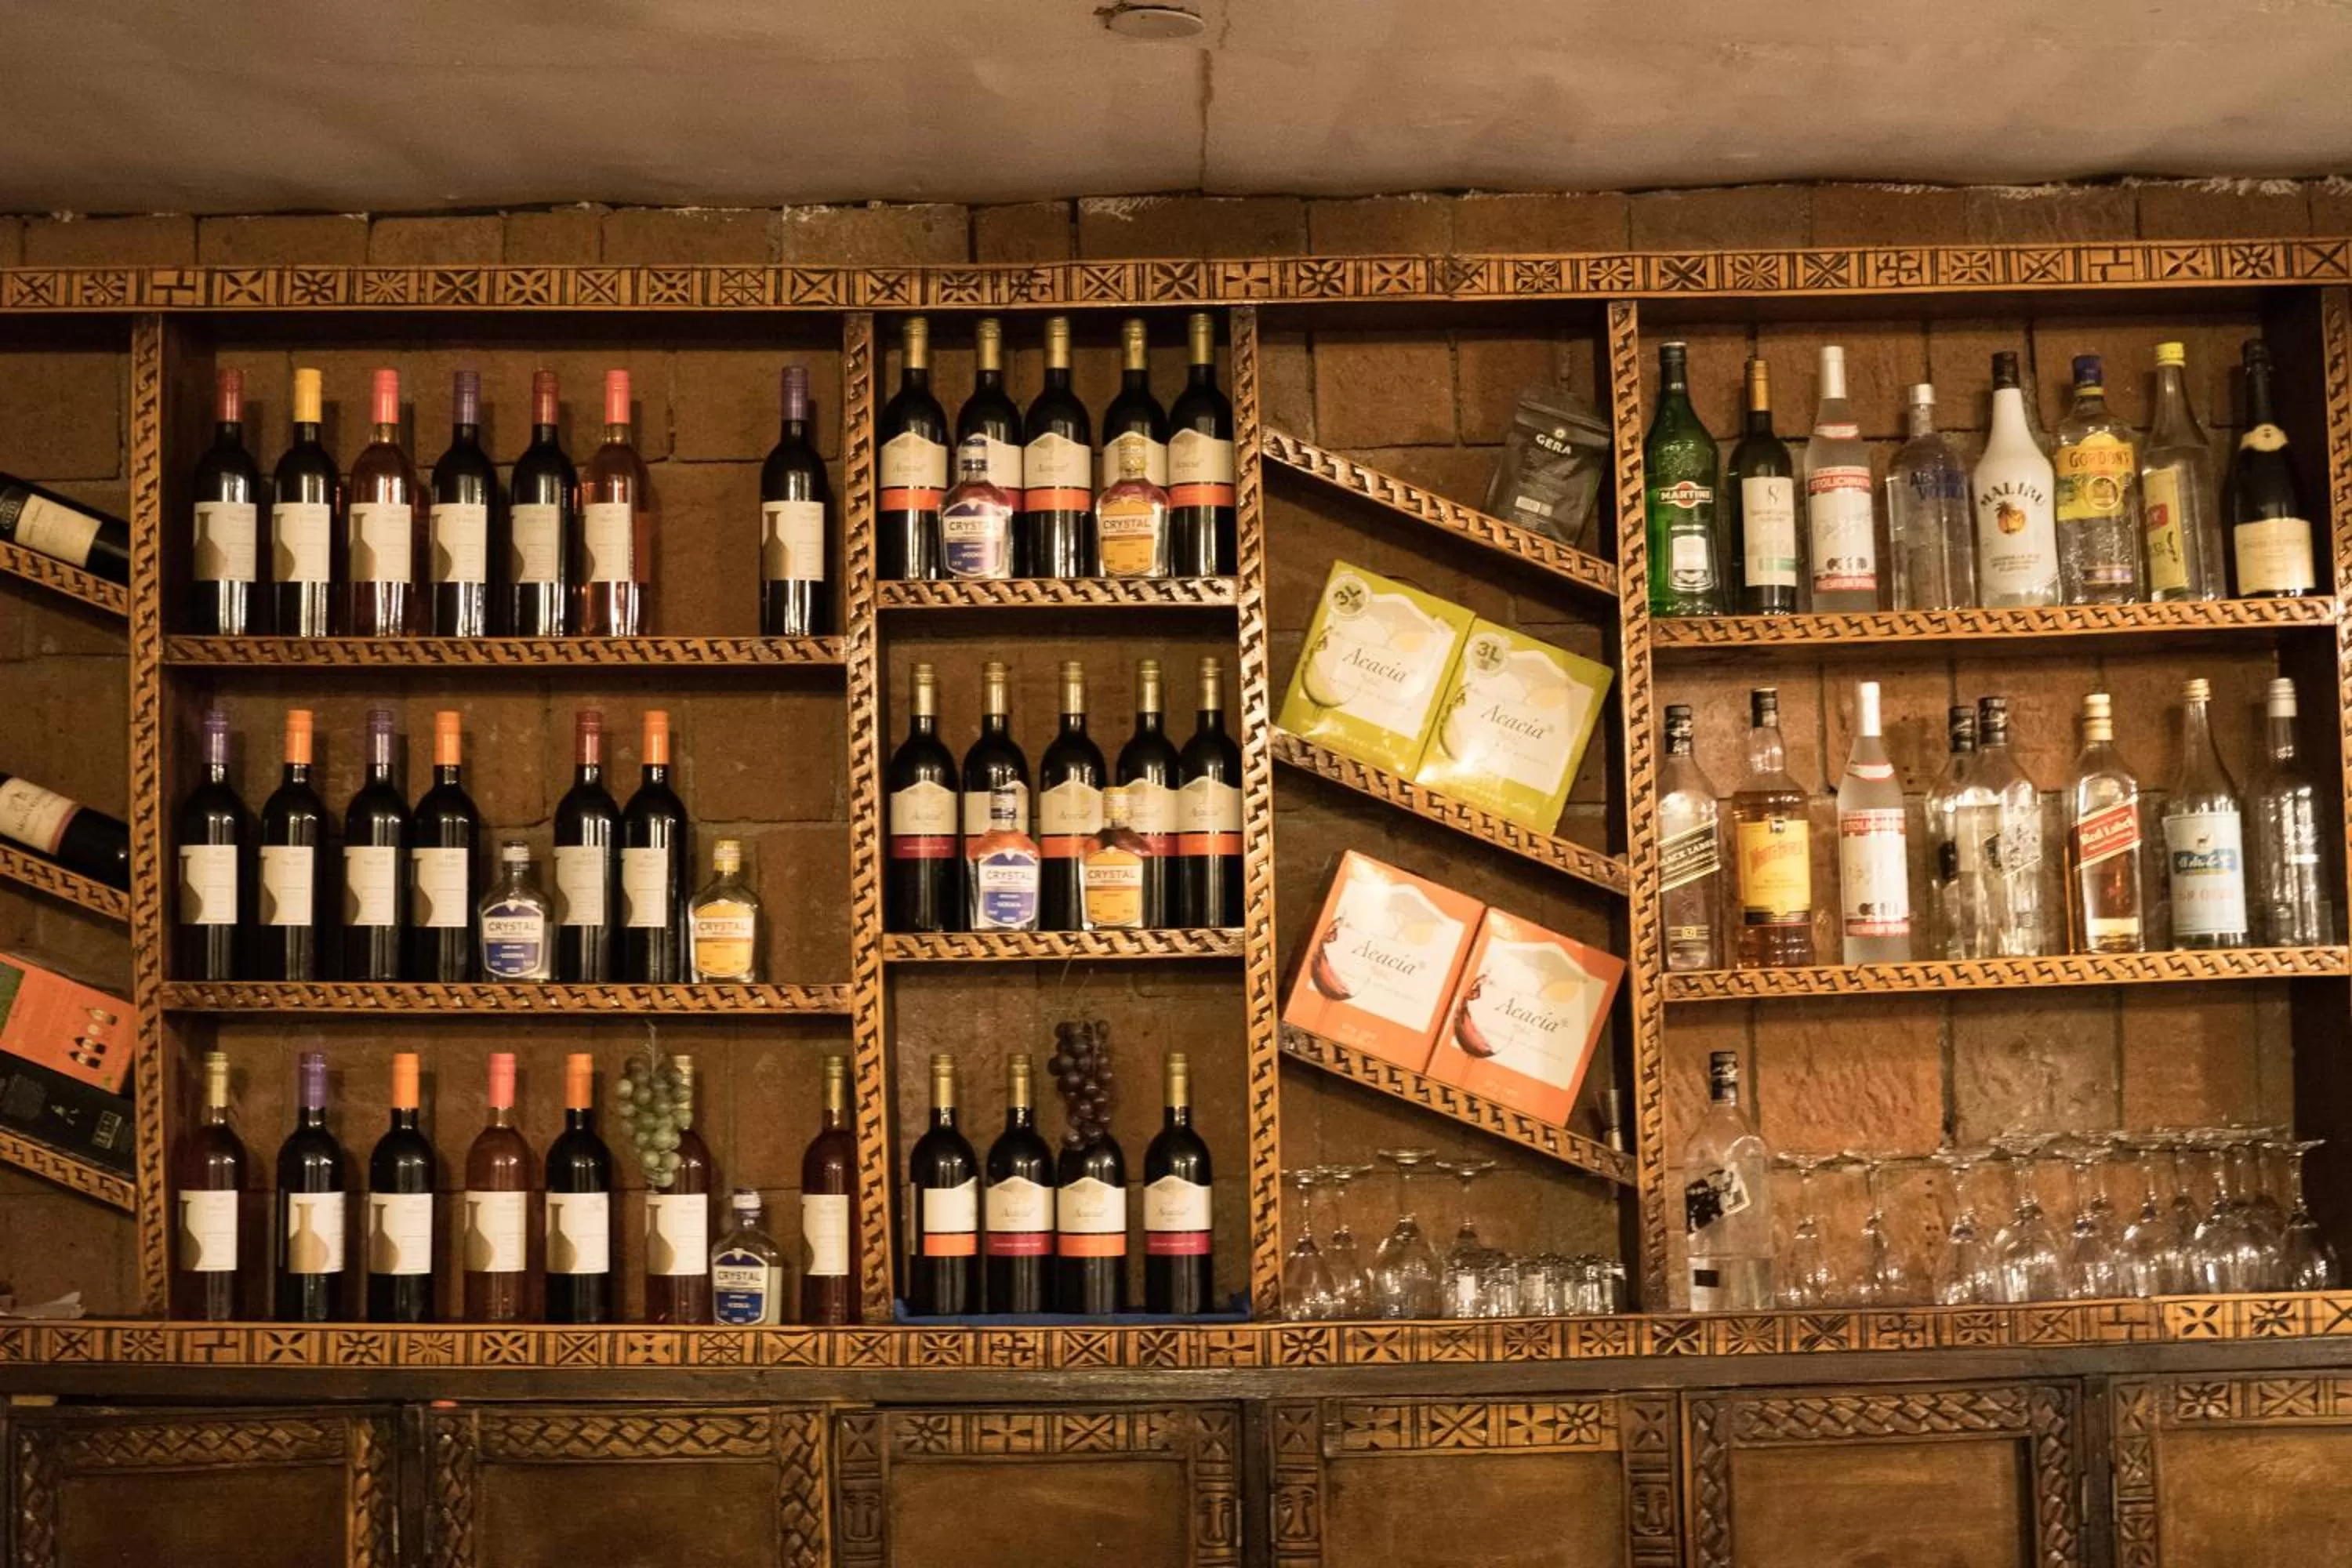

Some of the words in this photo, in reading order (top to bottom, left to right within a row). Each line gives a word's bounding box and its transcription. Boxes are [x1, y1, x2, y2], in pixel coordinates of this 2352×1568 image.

[1535, 434, 1571, 455] GERA
[1661, 490, 1711, 501] MARTINI
[1980, 482, 2045, 506] MALIBU
[1103, 518, 1152, 530] CRYSTAL
[1334, 586, 1361, 606] 3L
[1477, 641, 1499, 663] 3L
[1341, 648, 1407, 684] Acacia
[1480, 705, 1544, 739] Acacia
[986, 869, 1033, 880] CRYSTAL
[1087, 869, 1135, 880] CRYSTAL
[488, 921, 537, 931] CRYSTAL
[699, 921, 747, 931] CRYSTAL
[1351, 940, 1417, 976] Acacia
[1494, 997, 1559, 1033] Acacia
[717, 1271, 760, 1281] CRYSTAL
